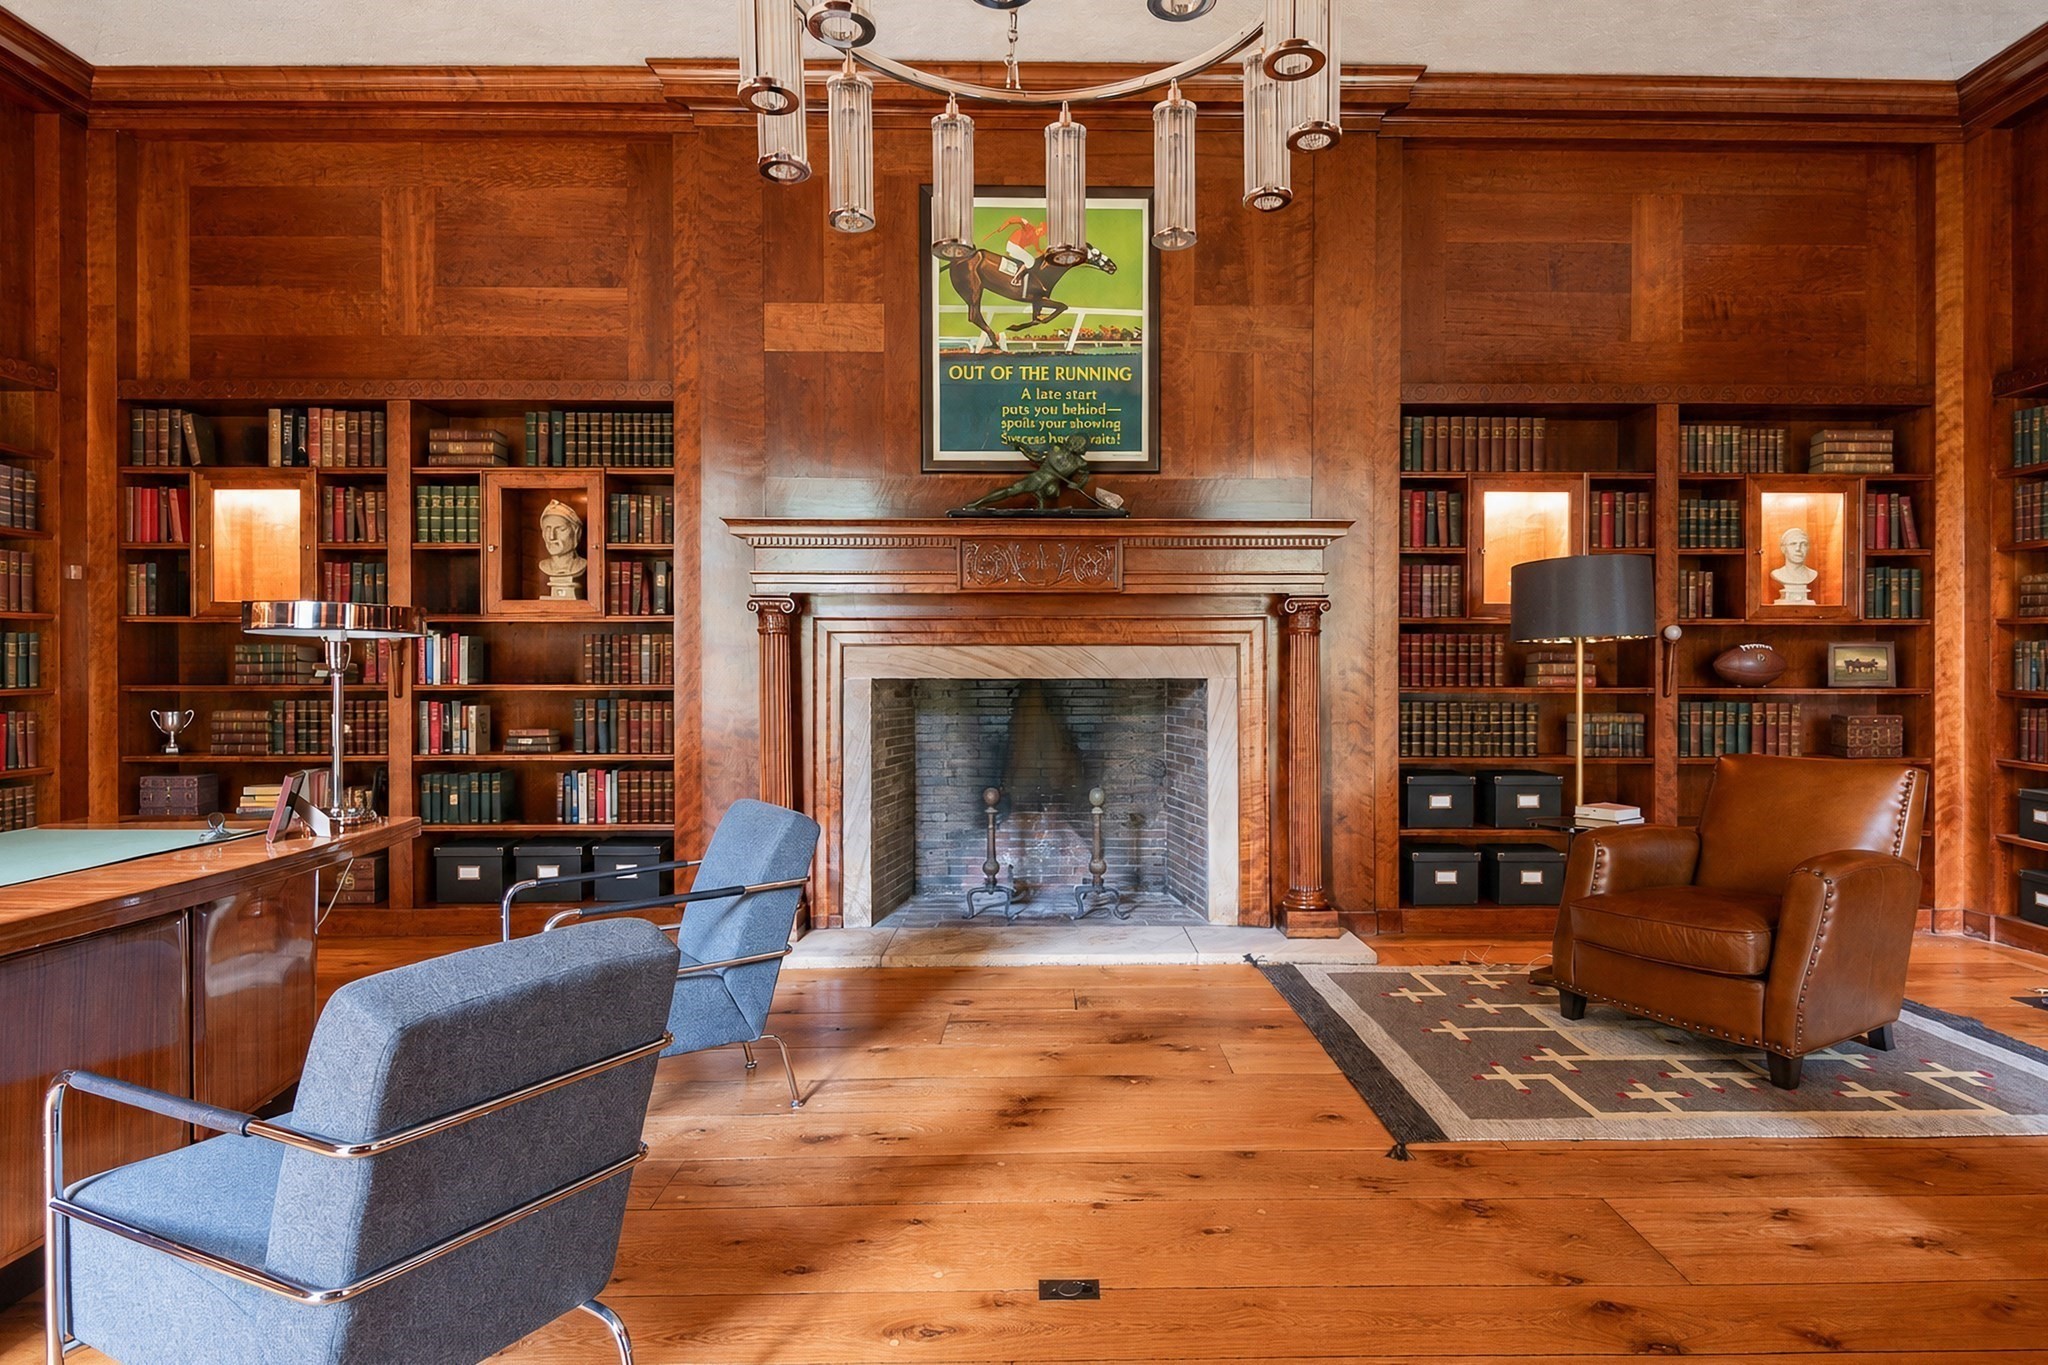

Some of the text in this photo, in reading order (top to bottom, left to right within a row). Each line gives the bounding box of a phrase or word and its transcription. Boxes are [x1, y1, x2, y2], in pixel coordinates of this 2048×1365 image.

[948, 365, 1133, 382] OUT OF THE RUNNING
[1020, 387, 1098, 400] A late start
[1002, 405, 1030, 418] puts
[1034, 405, 1058, 418] you
[1001, 417, 1121, 433] spoils your showing
